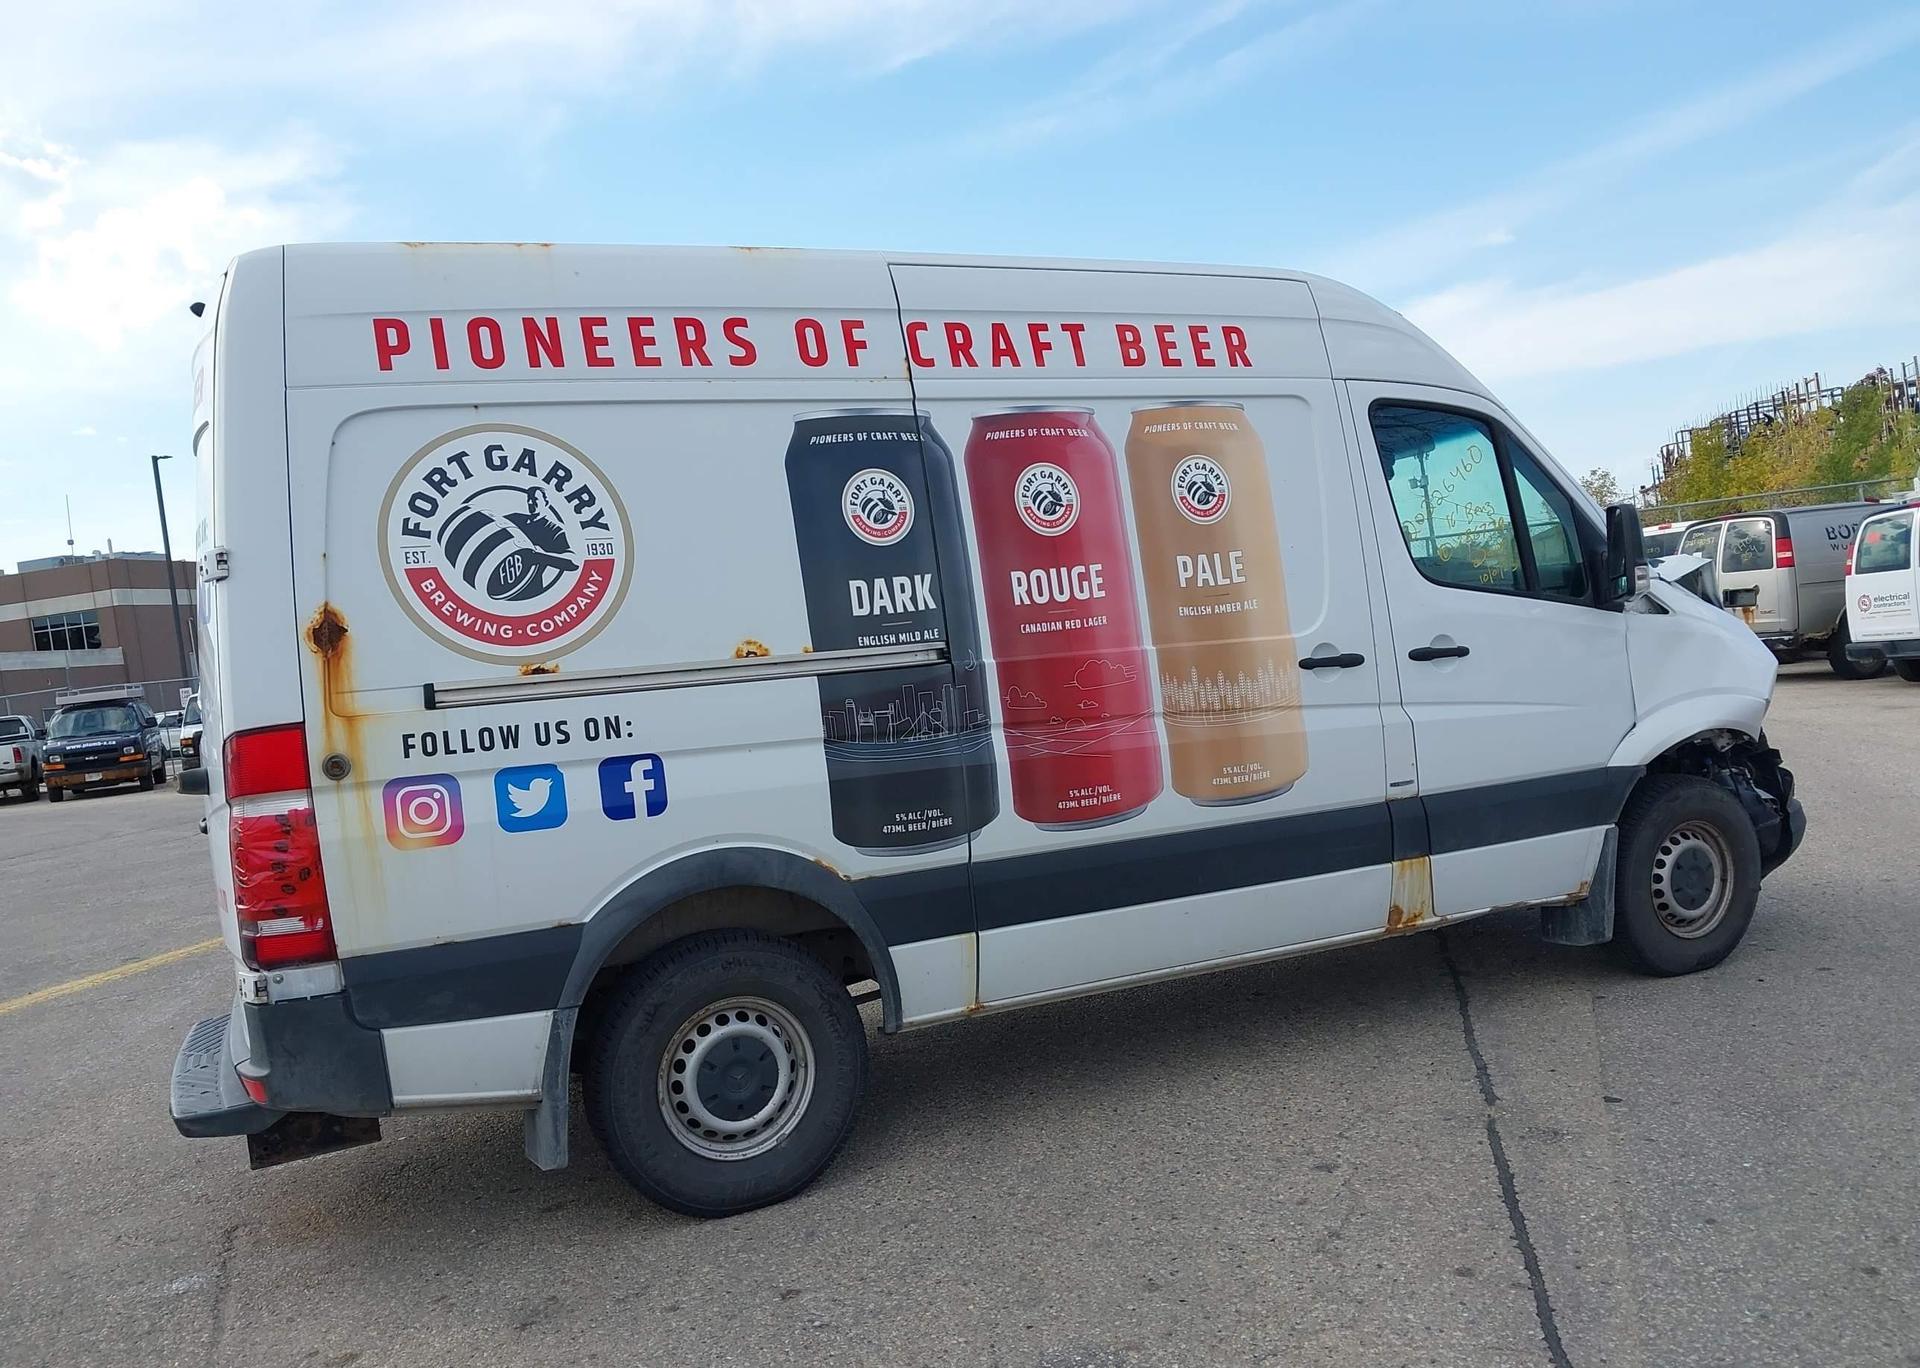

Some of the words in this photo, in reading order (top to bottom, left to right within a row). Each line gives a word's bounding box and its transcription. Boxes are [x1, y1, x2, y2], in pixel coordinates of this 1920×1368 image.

[371, 316, 758, 372] PIONEERS
[794, 317, 868, 367] OF
[905, 321, 1087, 368] CRAFT
[1115, 324, 1253, 368] BEER
[985, 429, 1025, 440] PIONEERS
[1028, 428, 1038, 437] OF
[1040, 428, 1065, 437] CRAFT
[1067, 429, 1089, 438] BEER
[1144, 422, 1181, 433] PIONEERS
[1183, 422, 1192, 430] OF
[1194, 421, 1217, 430] CRAFT
[1219, 422, 1240, 431] BEER
[809, 432, 854, 445] PIONEERS
[857, 432, 868, 441] OF
[871, 431, 898, 441] CRAFT
[1021, 472, 1039, 499] FORT
[1040, 470, 1072, 496] GARRY
[1178, 464, 1193, 489] FORT
[1194, 462, 1224, 487] GARRY
[401, 450, 475, 540] FORT
[483, 444, 611, 532] GARRY
[849, 479, 868, 507] FORT
[870, 477, 906, 504] GARRY
[855, 516, 882, 537] BREWING
[884, 513, 905, 536] COMPANY
[404, 550, 432, 565] EST.
[586, 542, 614, 556] 1930
[499, 554, 523, 585] FGB
[1176, 550, 1246, 588] PALE
[1010, 563, 1106, 606] ROUGE
[420, 578, 513, 639] BREWING
[526, 569, 603, 637] COMPANY
[848, 573, 937, 616] DARK
[1873, 592, 1910, 603] electrical
[1178, 605, 1212, 617] ENGLISH
[1214, 601, 1241, 614] AMBER
[1244, 599, 1259, 610] ALE
[1020, 621, 1063, 634] CANADIAN
[1065, 618, 1082, 630] RED
[1084, 615, 1108, 628] LAGER
[858, 634, 896, 647] ENGLISH
[899, 631, 920, 643] MILD
[923, 628, 940, 640] ALE
[402, 724, 520, 759] FOLLOW
[534, 720, 571, 746] US
[584, 715, 634, 742] ON:
[1212, 777, 1232, 785] 473ML
[1069, 789, 1080, 798] 5%
[1058, 800, 1079, 809] 473ML
[895, 813, 907, 822] 5%
[908, 808, 944, 820] ALC./VOL.
[882, 824, 906, 833] 473ML
[908, 817, 953, 831] BEER/BIÈRE
